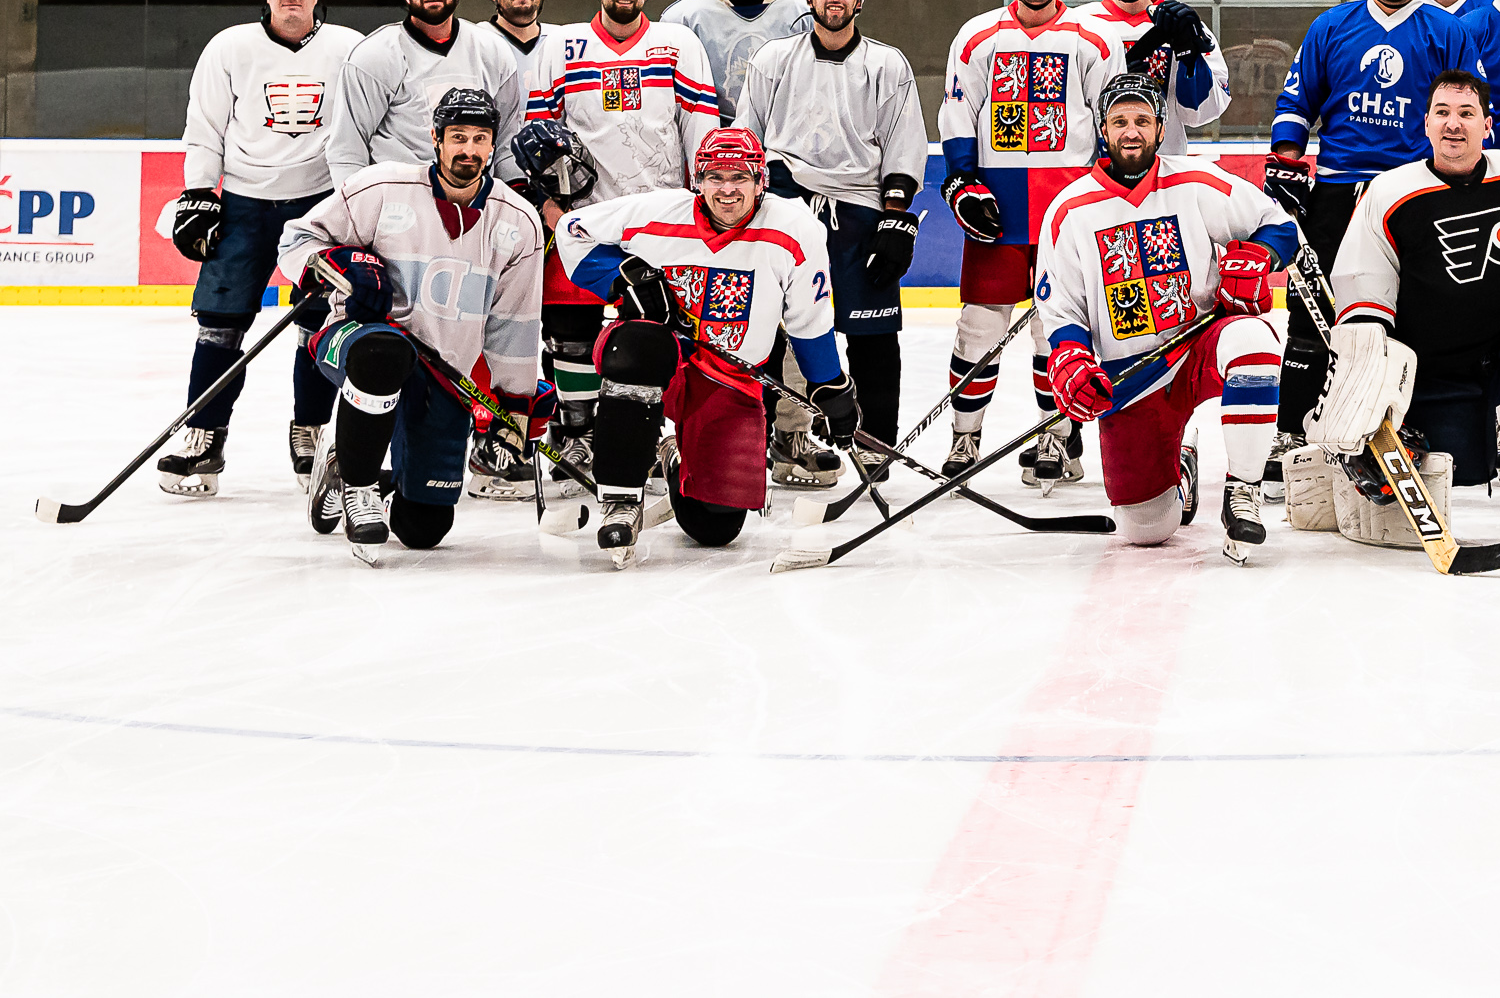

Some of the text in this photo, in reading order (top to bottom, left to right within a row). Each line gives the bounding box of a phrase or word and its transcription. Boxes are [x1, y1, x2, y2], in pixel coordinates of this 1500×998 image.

[564, 38, 588, 61] 57
[1348, 92, 1412, 118] CH&T
[1349, 115, 1405, 129] PARDUBICE
[1265, 167, 1311, 185] CCM
[45, 251, 95, 263] GROUP
[1036, 268, 1052, 303] 6
[849, 306, 899, 320] BAUER
[1285, 360, 1309, 370] CCM
[426, 479, 462, 490] BAUER
[1383, 450, 1443, 537] CCM
